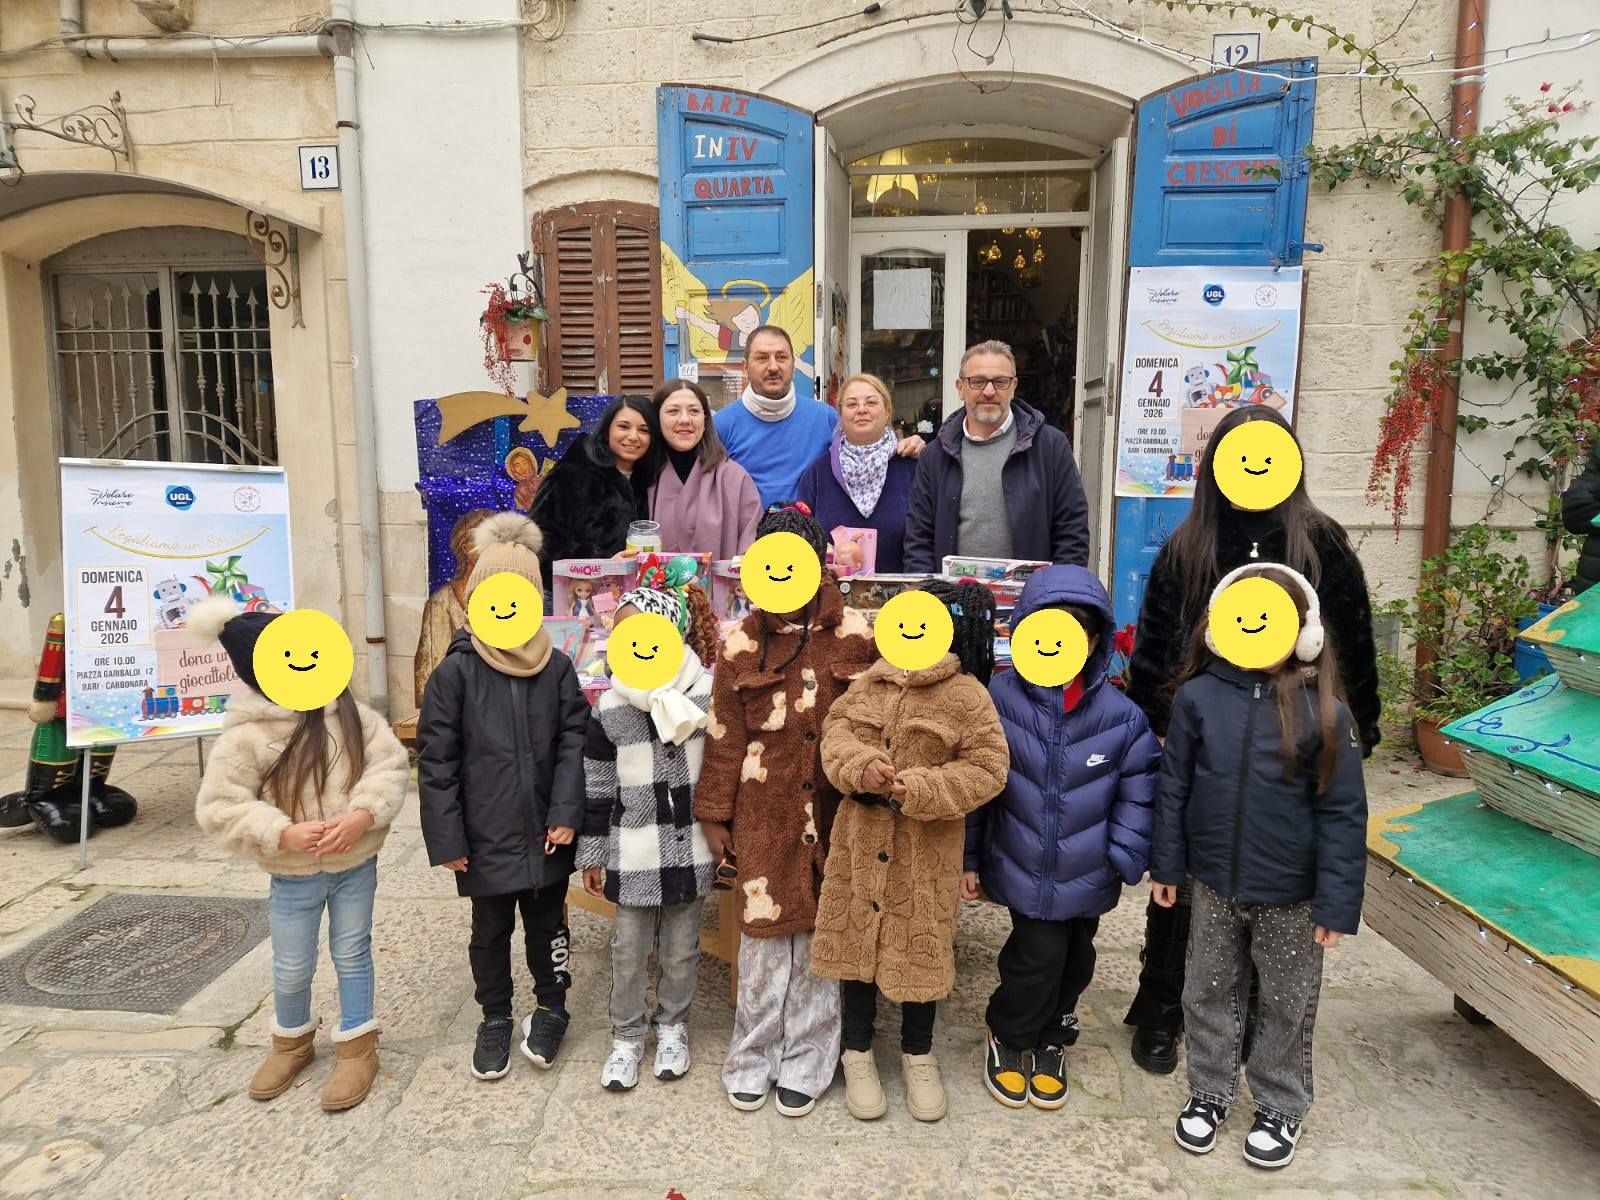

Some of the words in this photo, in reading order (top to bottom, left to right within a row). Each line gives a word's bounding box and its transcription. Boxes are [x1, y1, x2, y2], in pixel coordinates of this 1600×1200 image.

[1223, 44, 1249, 67] 12
[687, 92, 750, 117] BARI
[694, 134, 723, 158] IN
[726, 135, 758, 161] IV
[309, 155, 330, 179] 13
[694, 176, 775, 199] QUARTA
[1135, 358, 1178, 368] DOMENICA
[1148, 370, 1163, 397] 4
[1137, 398, 1170, 408] GENNAIO
[1143, 409, 1163, 418] 2026
[170, 493, 192, 501] UGL
[108, 524, 180, 551] Regaliamo
[82, 570, 143, 584] DOMENICA
[104, 585, 126, 619] 4
[91, 619, 137, 632] GENNAIO
[101, 632, 129, 645] 2026
[94, 657, 110, 667] ORE
[113, 656, 135, 666] 10.00
[179, 650, 212, 667] dona
[76, 670, 102, 680] PIAZZA
[145, 668, 153, 676] 12
[82, 682, 99, 691] BARI
[105, 679, 148, 690] CARBONARA
[550, 935, 569, 972] BOY
